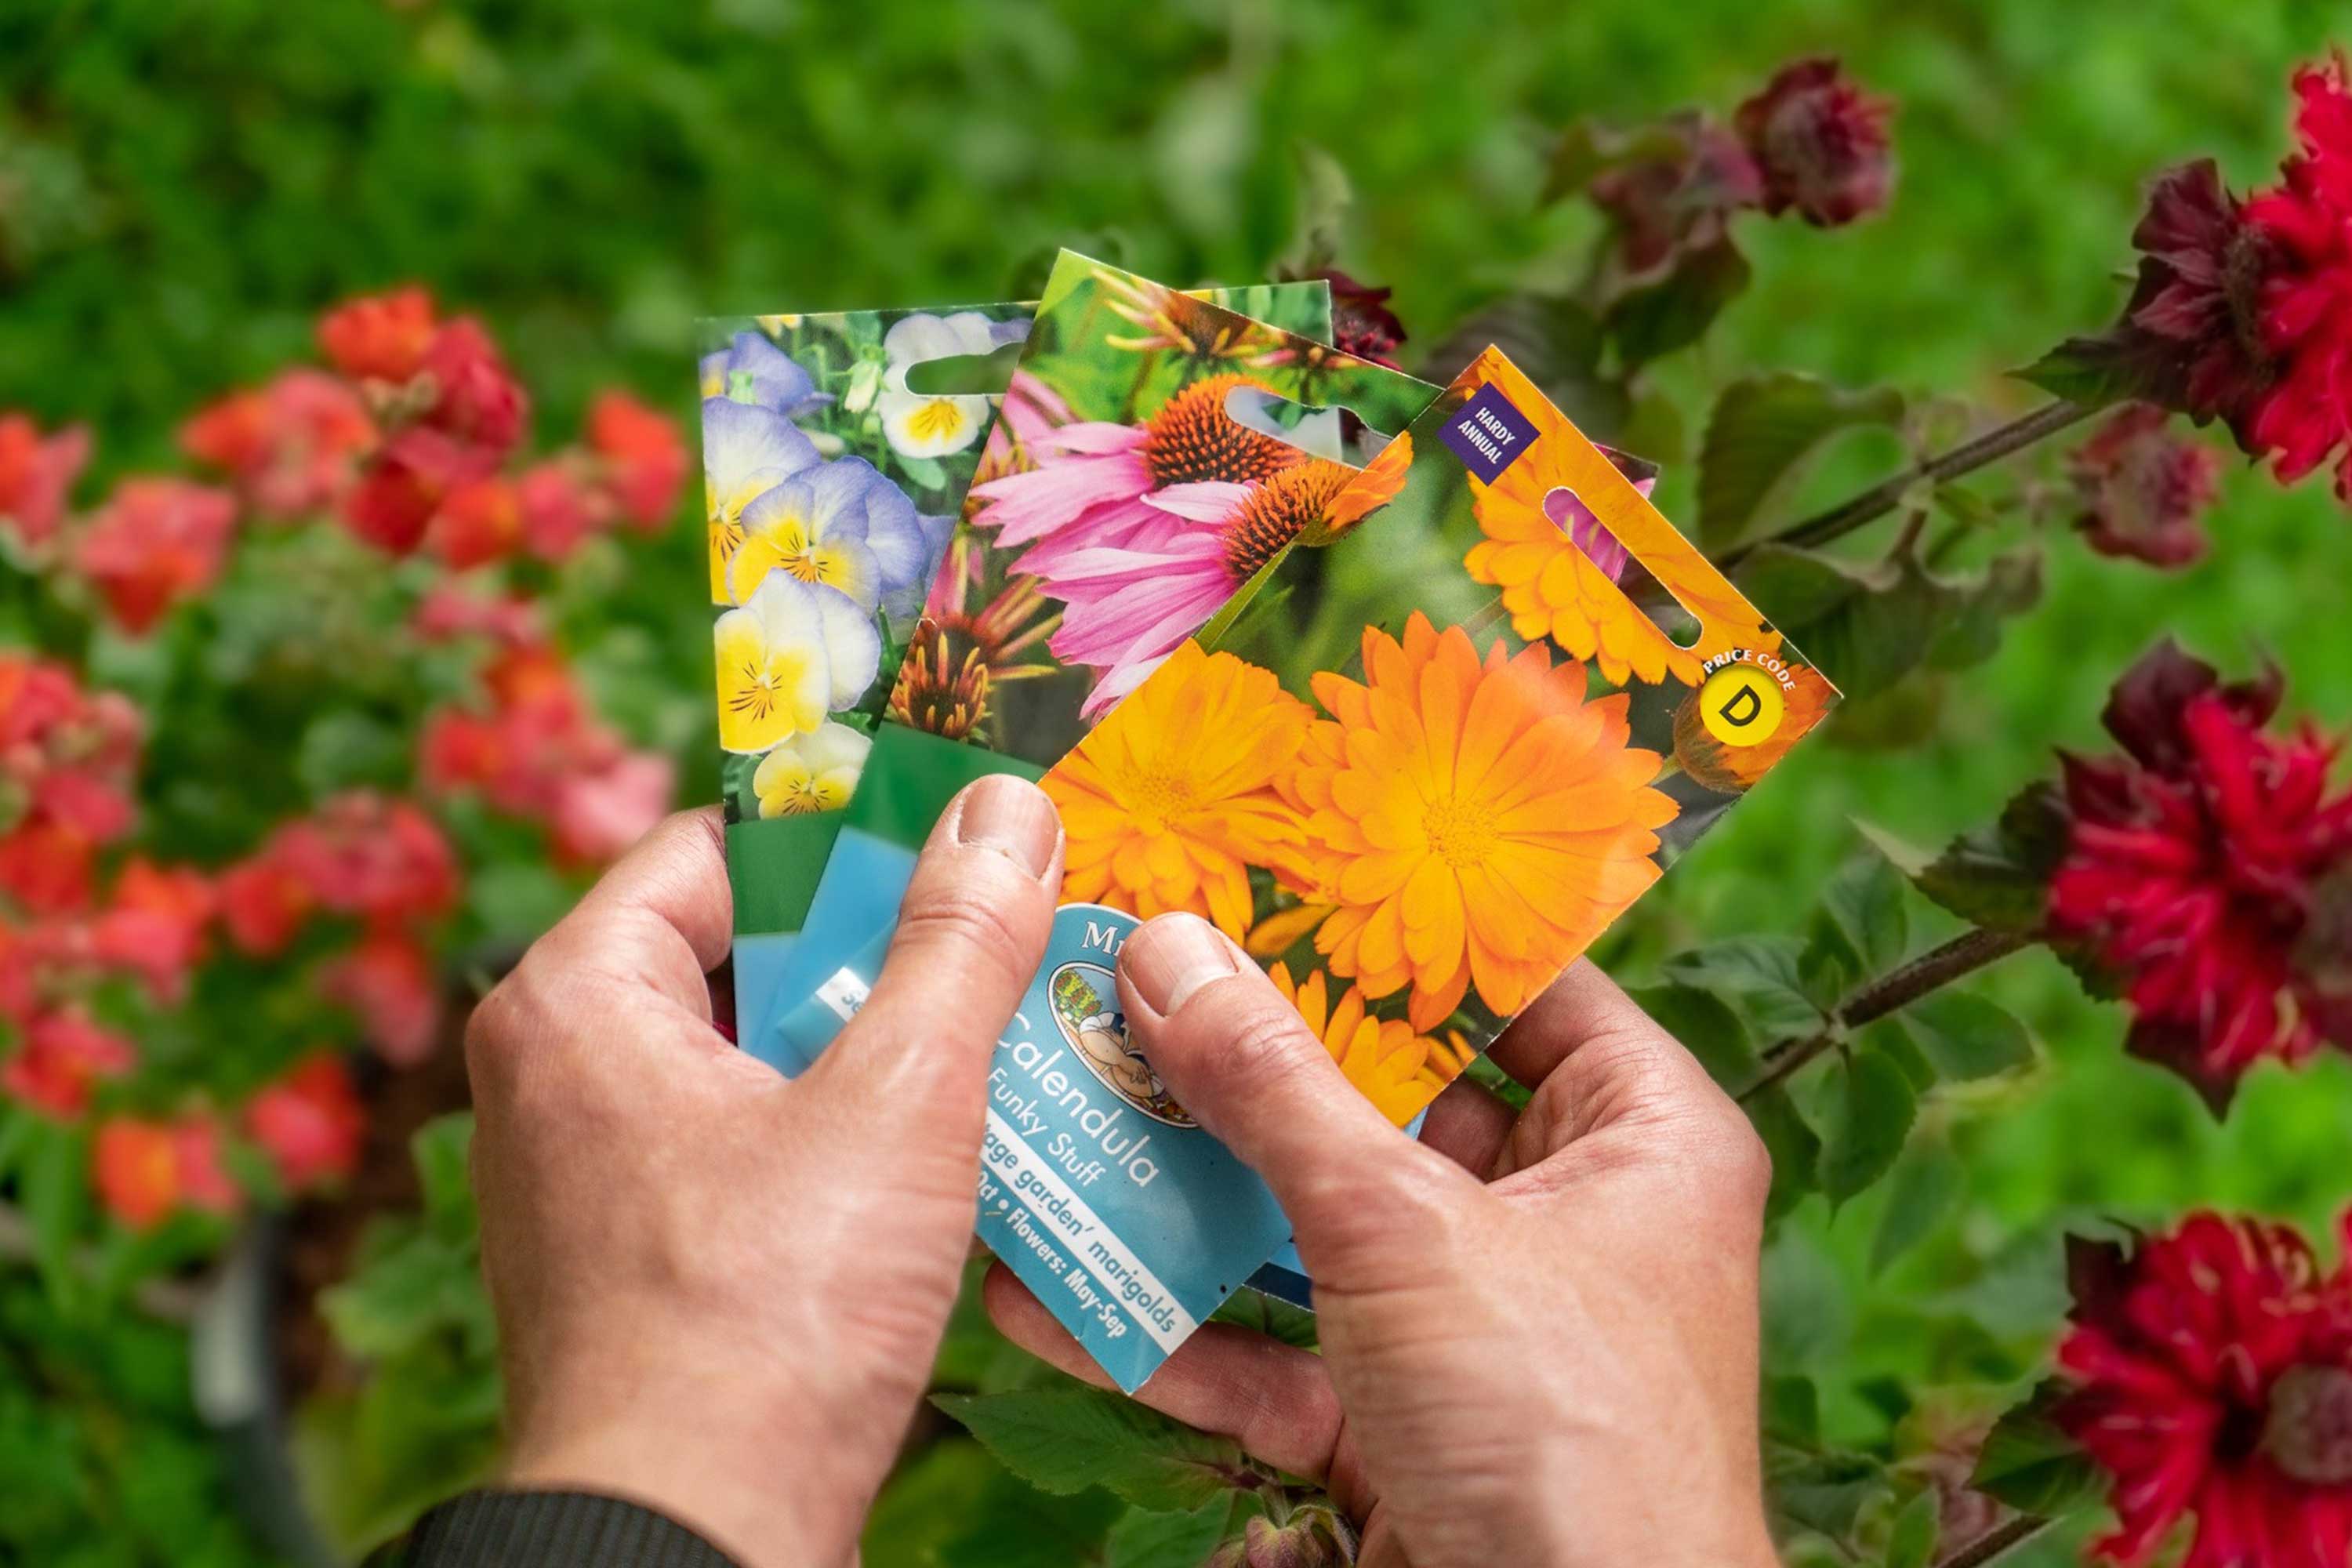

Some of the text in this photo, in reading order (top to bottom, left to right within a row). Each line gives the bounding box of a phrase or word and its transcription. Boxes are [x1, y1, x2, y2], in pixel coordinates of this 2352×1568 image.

[1457, 419, 1502, 464] ANNUAL
[1475, 407, 1515, 445] HARDY
[1703, 649, 1796, 691] PRICE CODE
[1719, 684, 1762, 727] D
[988, 1067, 1106, 1187] Funky Stuff
[997, 1012, 1160, 1187] Calendula
[982, 1122, 1018, 1169] age
[1087, 1241, 1175, 1333] marigolds
[1006, 1207, 1068, 1274] Flowers:
[1063, 1268, 1127, 1338] May-Sep
